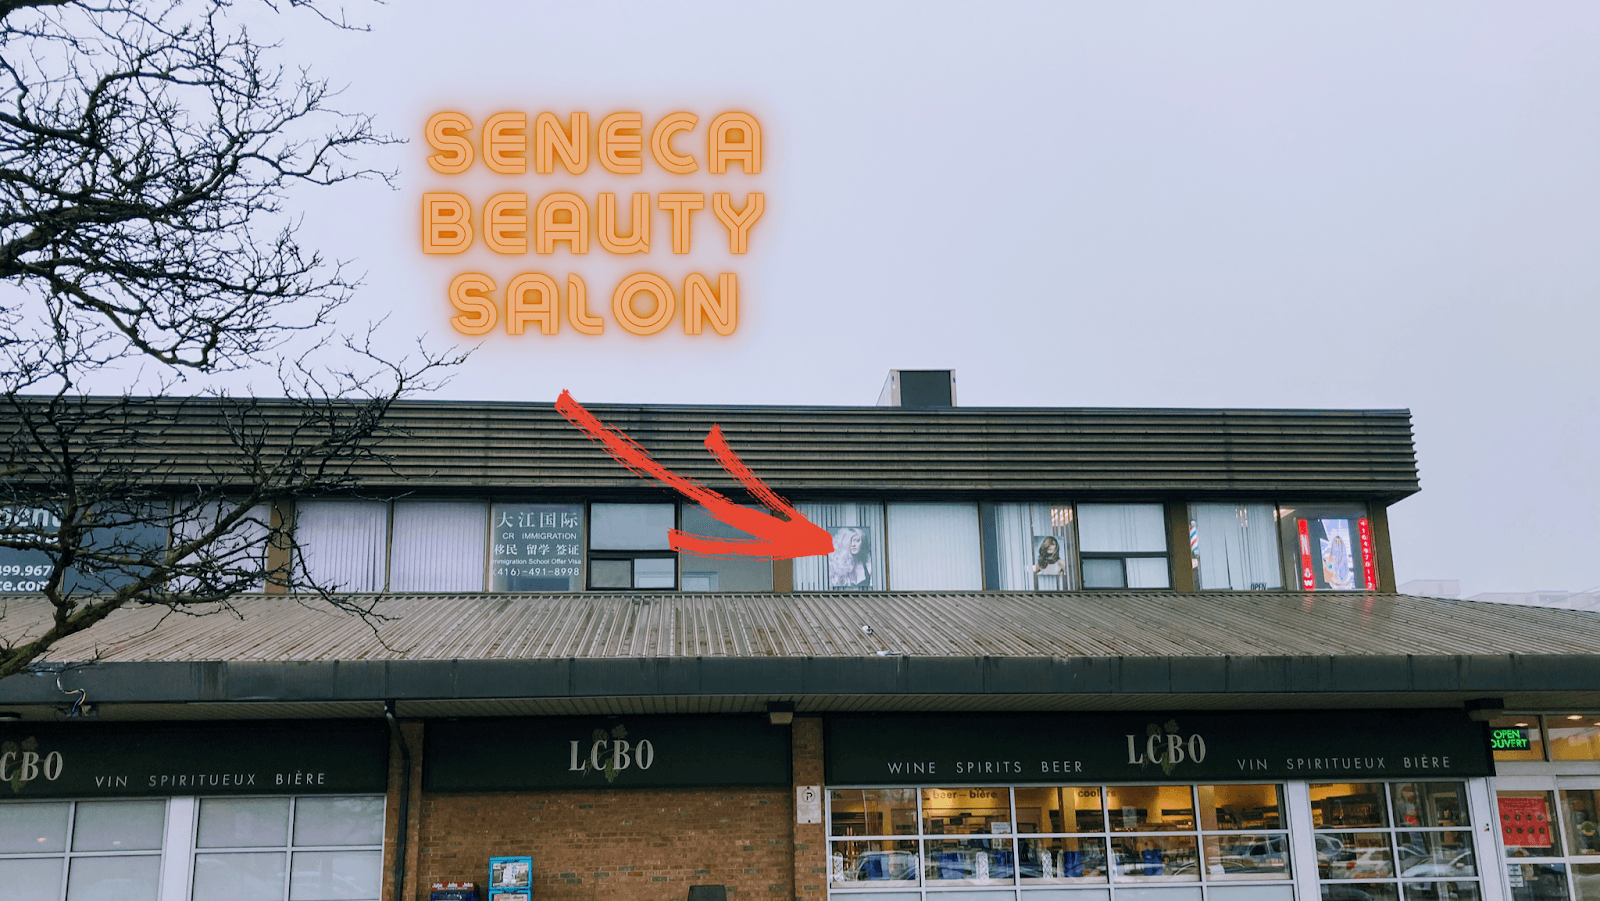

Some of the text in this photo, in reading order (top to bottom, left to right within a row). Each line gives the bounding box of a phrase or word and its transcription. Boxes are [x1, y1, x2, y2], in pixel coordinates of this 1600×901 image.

[497, 511, 578, 528] 大江国际
[502, 532, 577, 540] CR IMMIGRATION
[494, 544, 580, 556] 移民 留学 签证
[492, 567, 580, 577] (416)-491-8998
[1493, 729, 1520, 739] OPEN
[569, 739, 654, 771] LCBO
[1126, 734, 1206, 764] LCBO
[888, 760, 1083, 774] WINE SPIRITS BEER
[1237, 753, 1451, 770] VIN SPIRITUEUX BIÈRE
[95, 770, 326, 787] VIN SPIRITUEUX BIÈRE
[932, 789, 957, 799] beer
[1078, 788, 1117, 797] coolrs
